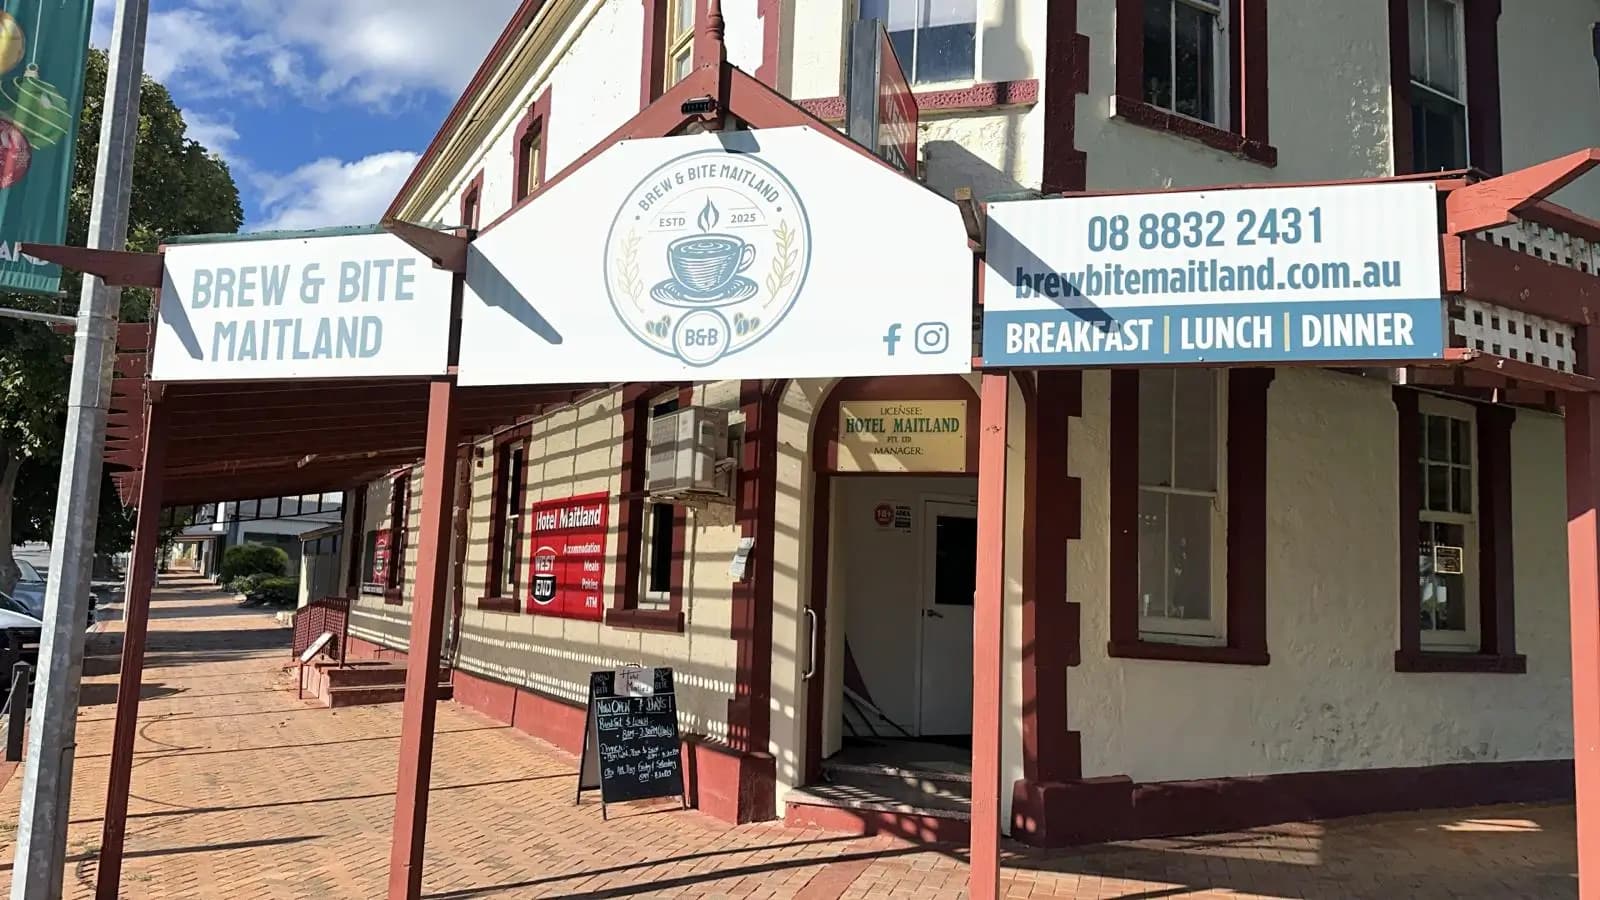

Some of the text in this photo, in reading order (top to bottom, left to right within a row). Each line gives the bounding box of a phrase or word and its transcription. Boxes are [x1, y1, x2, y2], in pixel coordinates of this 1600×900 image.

[638, 164, 780, 211] BREW & BITE MAITLAND
[659, 217, 686, 227] ESTD
[730, 213, 756, 224] 2025
[1088, 206, 1324, 252] 08 8832 2431
[191, 257, 416, 310] BREW & BITE
[1015, 256, 1402, 299] brewbitemaitland.com.au
[211, 315, 384, 361] MAITLAND
[1006, 312, 1415, 355] BREAKFAST LUNCH DINNER
[880, 407, 923, 415] LICENSEE:
[846, 417, 960, 433] HOTEL MAITLAND
[873, 446, 924, 455] MANAGER:
[536, 504, 602, 530] Hotel Maitland
[535, 555, 556, 572] WEST
[583, 560, 599, 572] Meals
[535, 579, 552, 596] END
[585, 596, 598, 609] ATM
